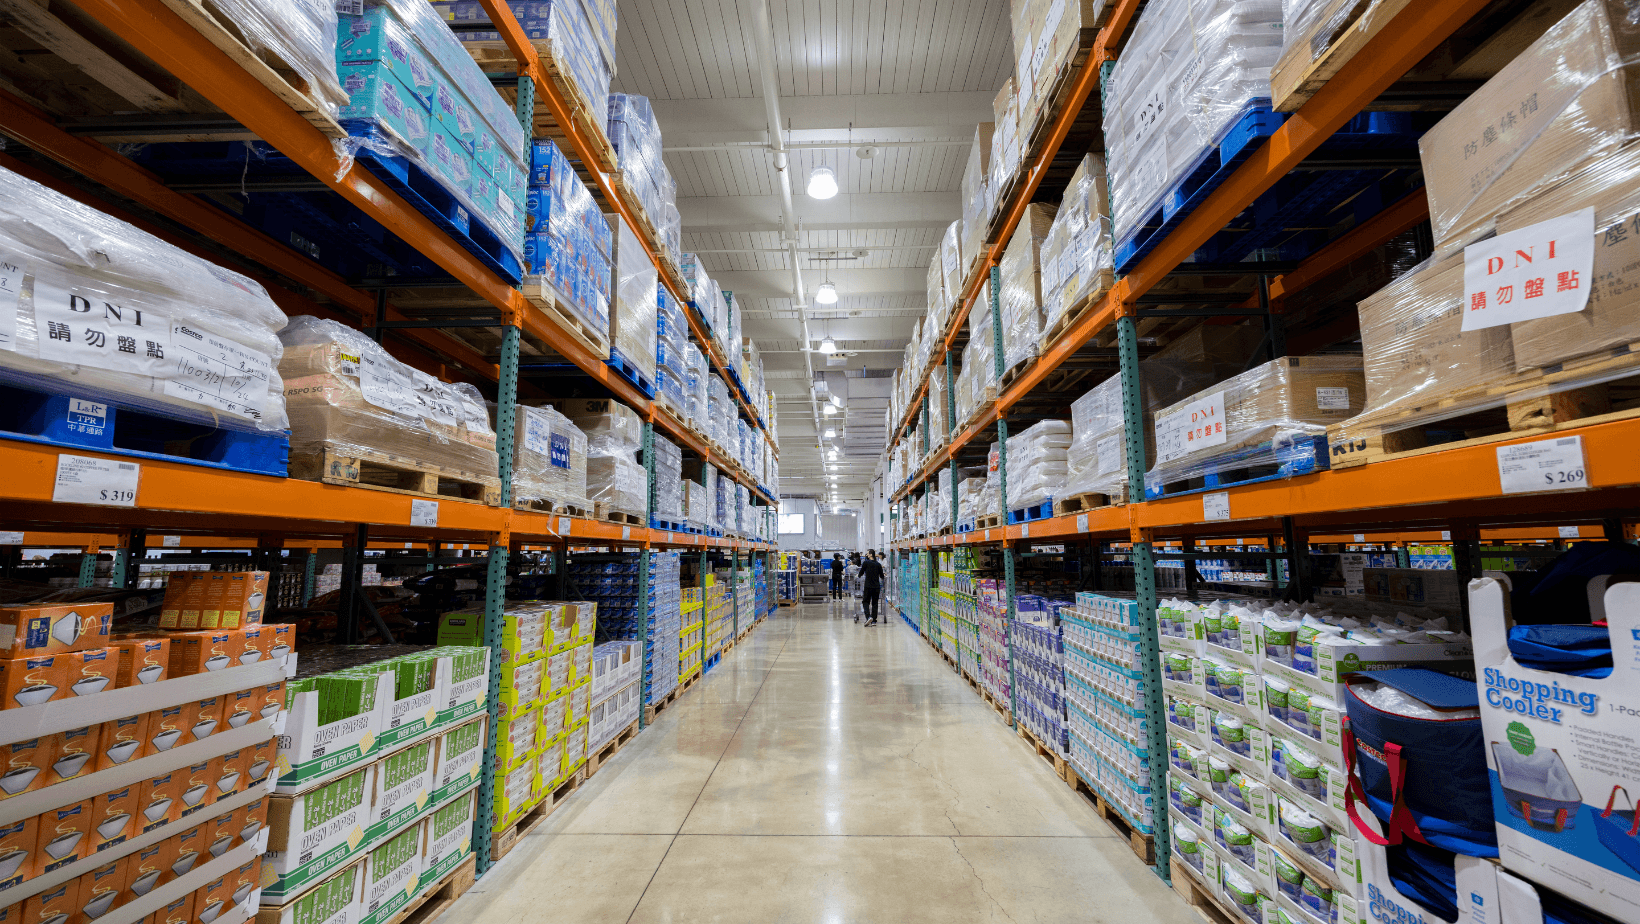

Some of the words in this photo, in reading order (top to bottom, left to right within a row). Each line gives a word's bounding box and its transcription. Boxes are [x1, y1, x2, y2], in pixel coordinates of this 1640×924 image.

[1487, 239, 1557, 276] DNI
[1470, 269, 1580, 312] 請勿盤點
[68, 293, 143, 327] DNI
[48, 320, 164, 359] 請勿盤點
[586, 401, 609, 412] 3M
[77, 414, 97, 425] TPR
[1557, 469, 1584, 483] 269
[111, 490, 134, 502] 319
[1484, 666, 1598, 714] Shopping
[391, 702, 410, 717] OVEN
[410, 693, 431, 710] PAPER
[1486, 685, 1562, 724] Cooler
[314, 724, 340, 744] OVEN
[340, 716, 369, 736] PAPER
[397, 728, 409, 739] OVEN
[410, 722, 424, 734] PAPER
[1573, 725, 1602, 736] Padded
[1602, 731, 1635, 744] Handles
[1575, 732, 1601, 744] Internal
[1601, 739, 1624, 749] Bottle
[1575, 740, 1596, 750] Smart
[1577, 748, 1611, 761] Vertically
[321, 757, 338, 771] OVEN
[338, 749, 358, 764] PAPER
[1595, 766, 1620, 777] Height
[382, 790, 401, 807] OVEN
[401, 777, 423, 795] PAPER
[400, 808, 416, 823] PAPER
[301, 827, 327, 851] OVEN
[328, 811, 357, 836] PAPER
[308, 862, 325, 876] OVEN
[325, 847, 346, 866] PAPER
[370, 878, 390, 900] OVEN
[391, 862, 413, 883] PAPER
